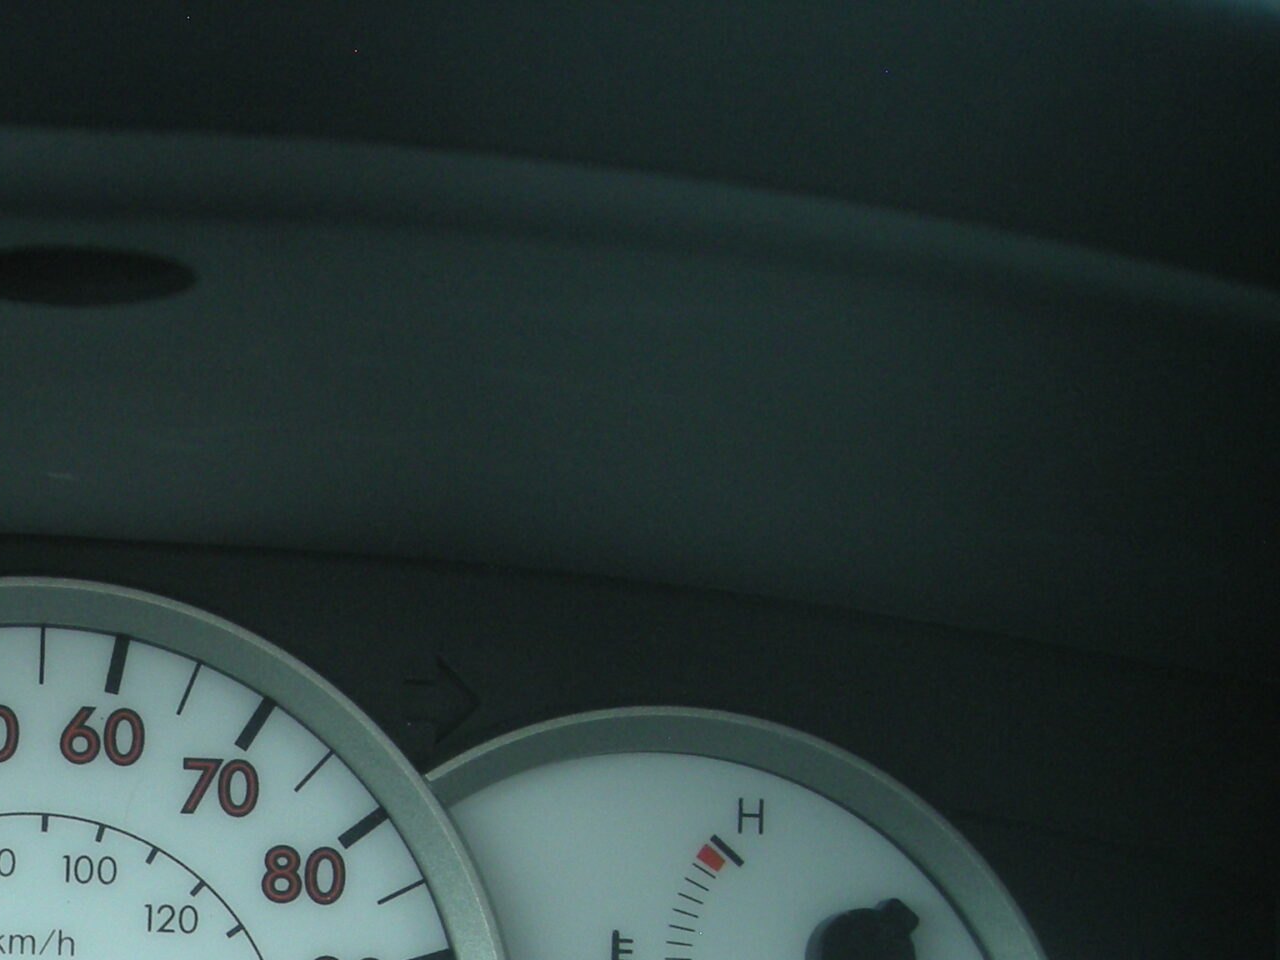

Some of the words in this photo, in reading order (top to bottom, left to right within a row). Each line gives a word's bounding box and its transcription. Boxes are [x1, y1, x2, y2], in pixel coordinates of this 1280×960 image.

[59, 706, 145, 766] 60
[180, 757, 259, 818] 70
[737, 797, 764, 835] H
[62, 854, 118, 885] 100
[261, 844, 346, 905] 80
[145, 903, 199, 934] 120
